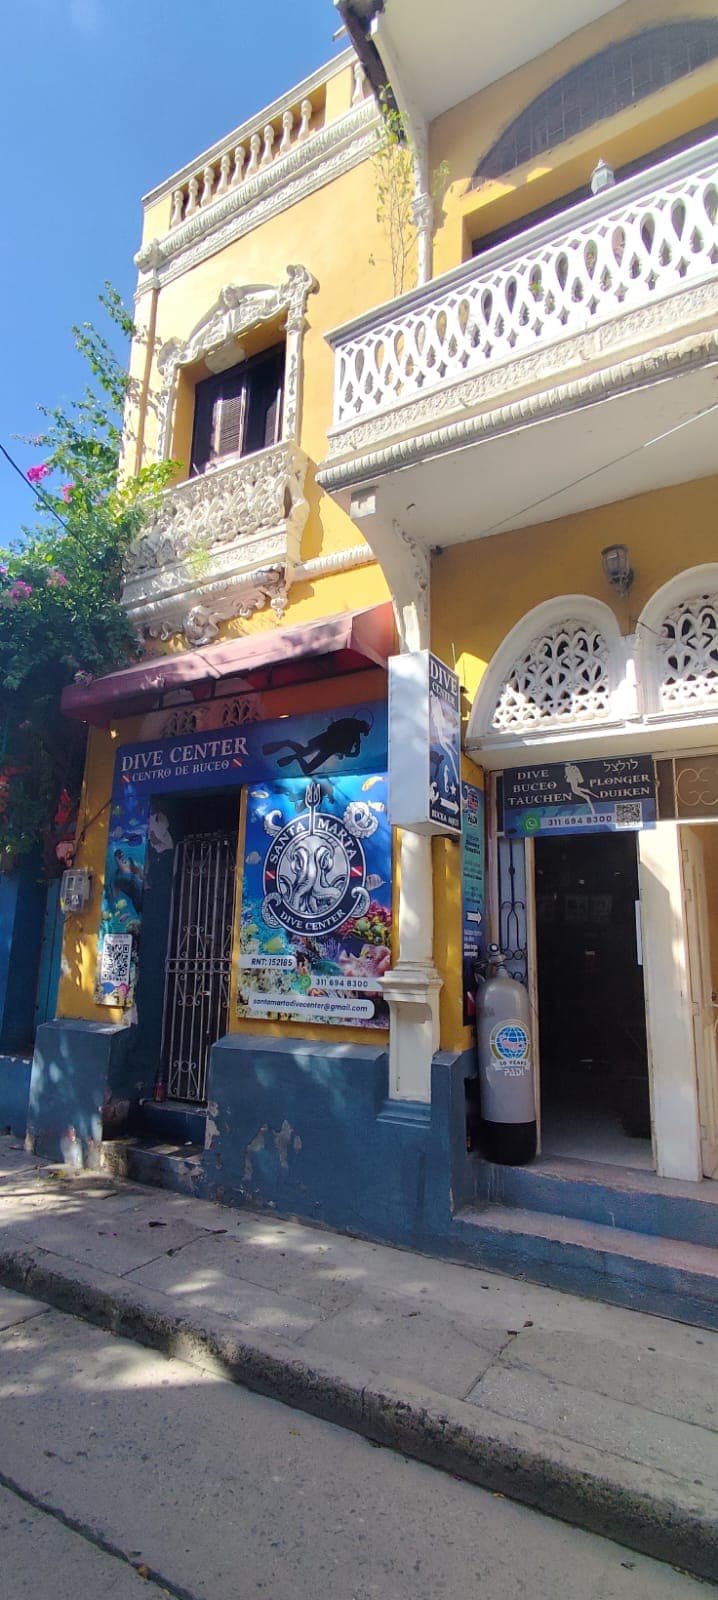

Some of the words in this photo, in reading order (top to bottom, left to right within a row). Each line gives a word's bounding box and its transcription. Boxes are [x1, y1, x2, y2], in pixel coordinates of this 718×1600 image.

[430, 659, 458, 697] DIVE
[431, 680, 456, 707] CENTER
[121, 750, 163, 771] DIVE
[170, 737, 249, 762] CENTER
[132, 769, 171, 782] CENTRO
[175, 765, 189, 777] DE
[192, 760, 230, 773] BUCEO
[517, 770, 549, 780] DIVE
[512, 781, 557, 793] BUCEO
[589, 773, 651, 788] PLONGER
[507, 791, 573, 806] TAUCHEN
[599, 786, 651, 799] DUIKEN
[548, 818, 562, 827] 311
[564, 816, 583, 826] 694
[587, 815, 613, 824] 8300
[269, 822, 306, 865] SANTA
[317, 817, 358, 862] MARTA
[279, 909, 304, 930] DIVE
[305, 908, 348, 932] CENTER
[315, 978, 327, 986] 311
[329, 979, 344, 987] 694
[347, 980, 369, 988] 8300
[253, 999, 368, 1012] santamartadivecenter@gmail.com
[504, 1067, 525, 1077] PADI
